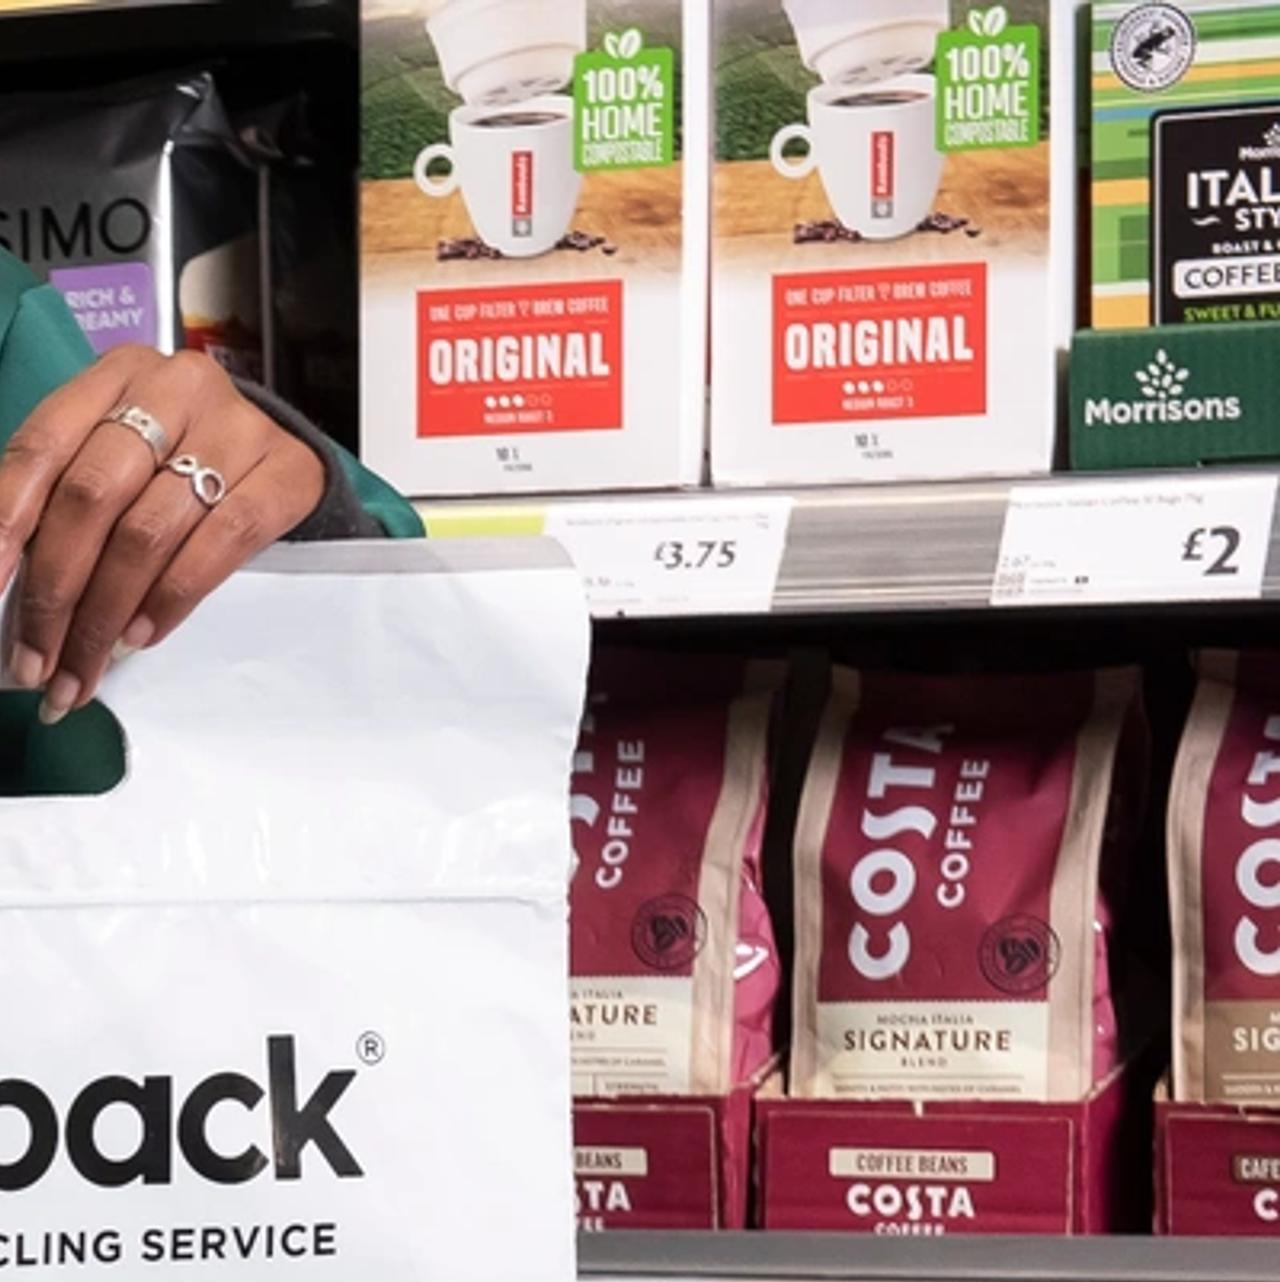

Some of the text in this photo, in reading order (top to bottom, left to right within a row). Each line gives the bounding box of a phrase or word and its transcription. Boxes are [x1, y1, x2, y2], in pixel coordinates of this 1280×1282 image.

[945, 44, 1029, 82] 100%
[583, 66, 662, 103] 100%
[945, 82, 1028, 121] HOME
[582, 103, 662, 141] HOME
[945, 119, 1029, 146] COMPOSTABLE
[119, 285, 136, 305] &
[1183, 303, 1239, 321] SWEET
[429, 331, 610, 385] ORIGINAL
[784, 315, 974, 370] ORIGINAL
[1084, 396, 1241, 426] Morrisons
[654, 540, 736, 570] £3.75
[1181, 525, 1241, 577] £2
[595, 739, 645, 889] COFFEE
[848, 723, 954, 981] COSTA
[937, 759, 990, 908] COFFEE
[844, 1029, 1012, 1051] SIGNATURE
[575, 1152, 622, 1169] BEANS
[856, 1155, 967, 1173] COFFEE BEANS
[847, 1183, 974, 1220] COSTA
[141, 1224, 337, 1262] SERVICE
